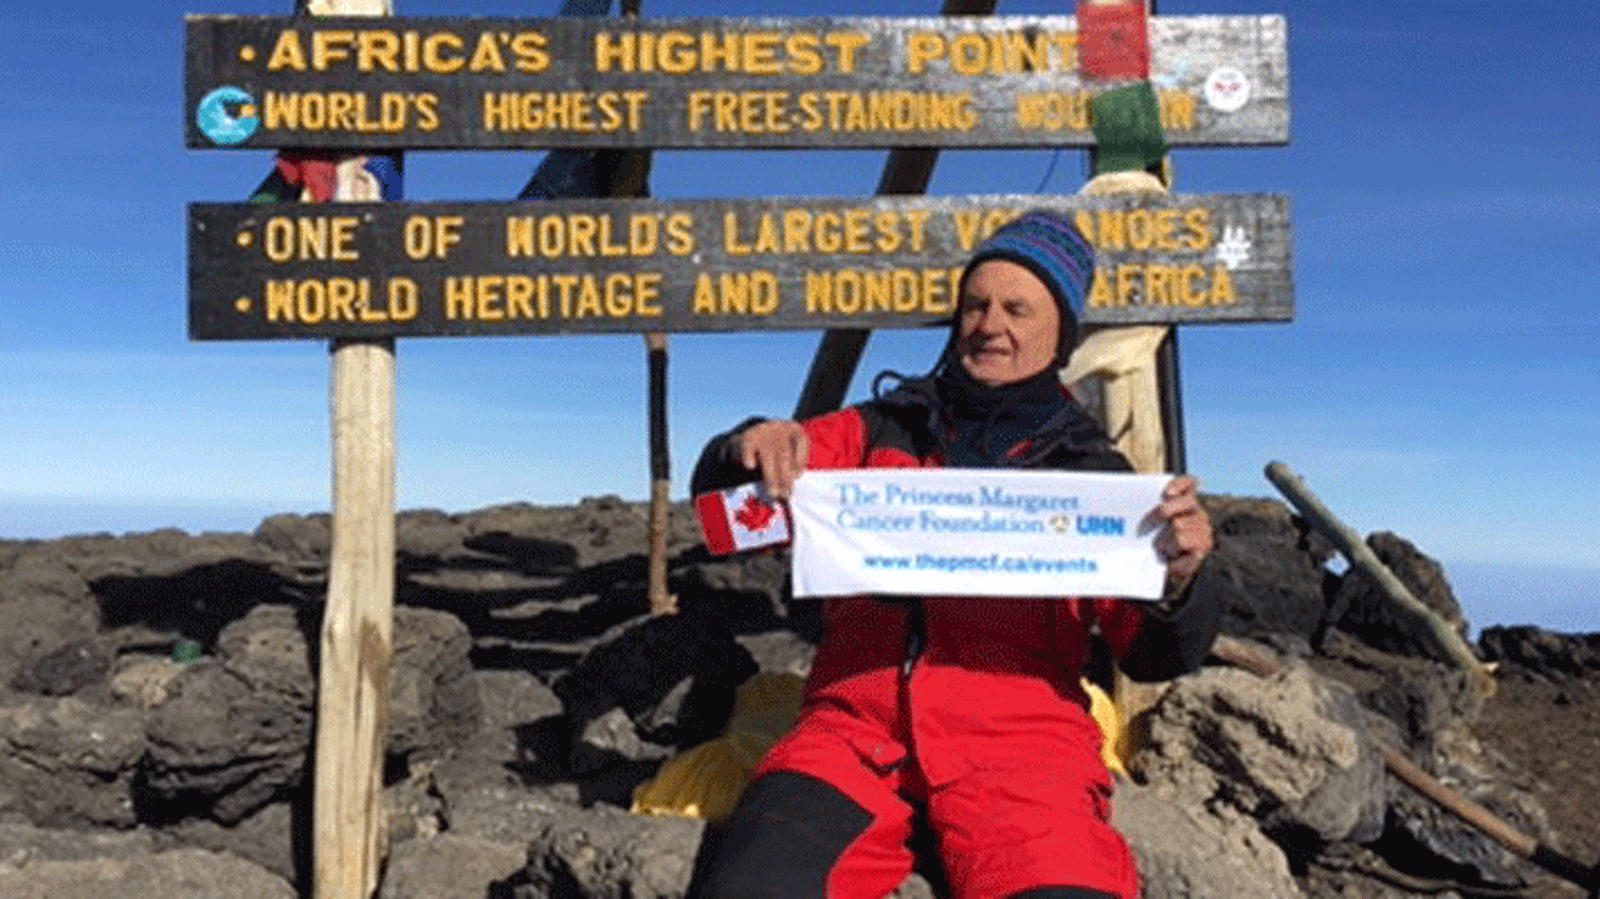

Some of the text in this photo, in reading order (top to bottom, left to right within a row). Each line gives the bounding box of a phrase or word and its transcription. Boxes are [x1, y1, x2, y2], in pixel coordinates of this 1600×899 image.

[267, 29, 551, 73] AFRICA'S
[594, 31, 870, 75] HIGHEST
[263, 89, 1197, 133] WORLD'S HIGHEST FREE-STANDING MOUIN
[265, 215, 359, 261] ONE
[404, 215, 465, 259] OF
[506, 212, 695, 258] WORLD'S
[724, 209, 930, 254] LARGEST
[265, 276, 418, 323] WORLD
[445, 273, 663, 320] HERITAGE
[692, 269, 779, 316] AND
[1088, 263, 1236, 308] AFRICA
[835, 482, 1078, 514] The Princess Margaret
[836, 509, 915, 532] Cancer
[919, 509, 1044, 533] Foundation
